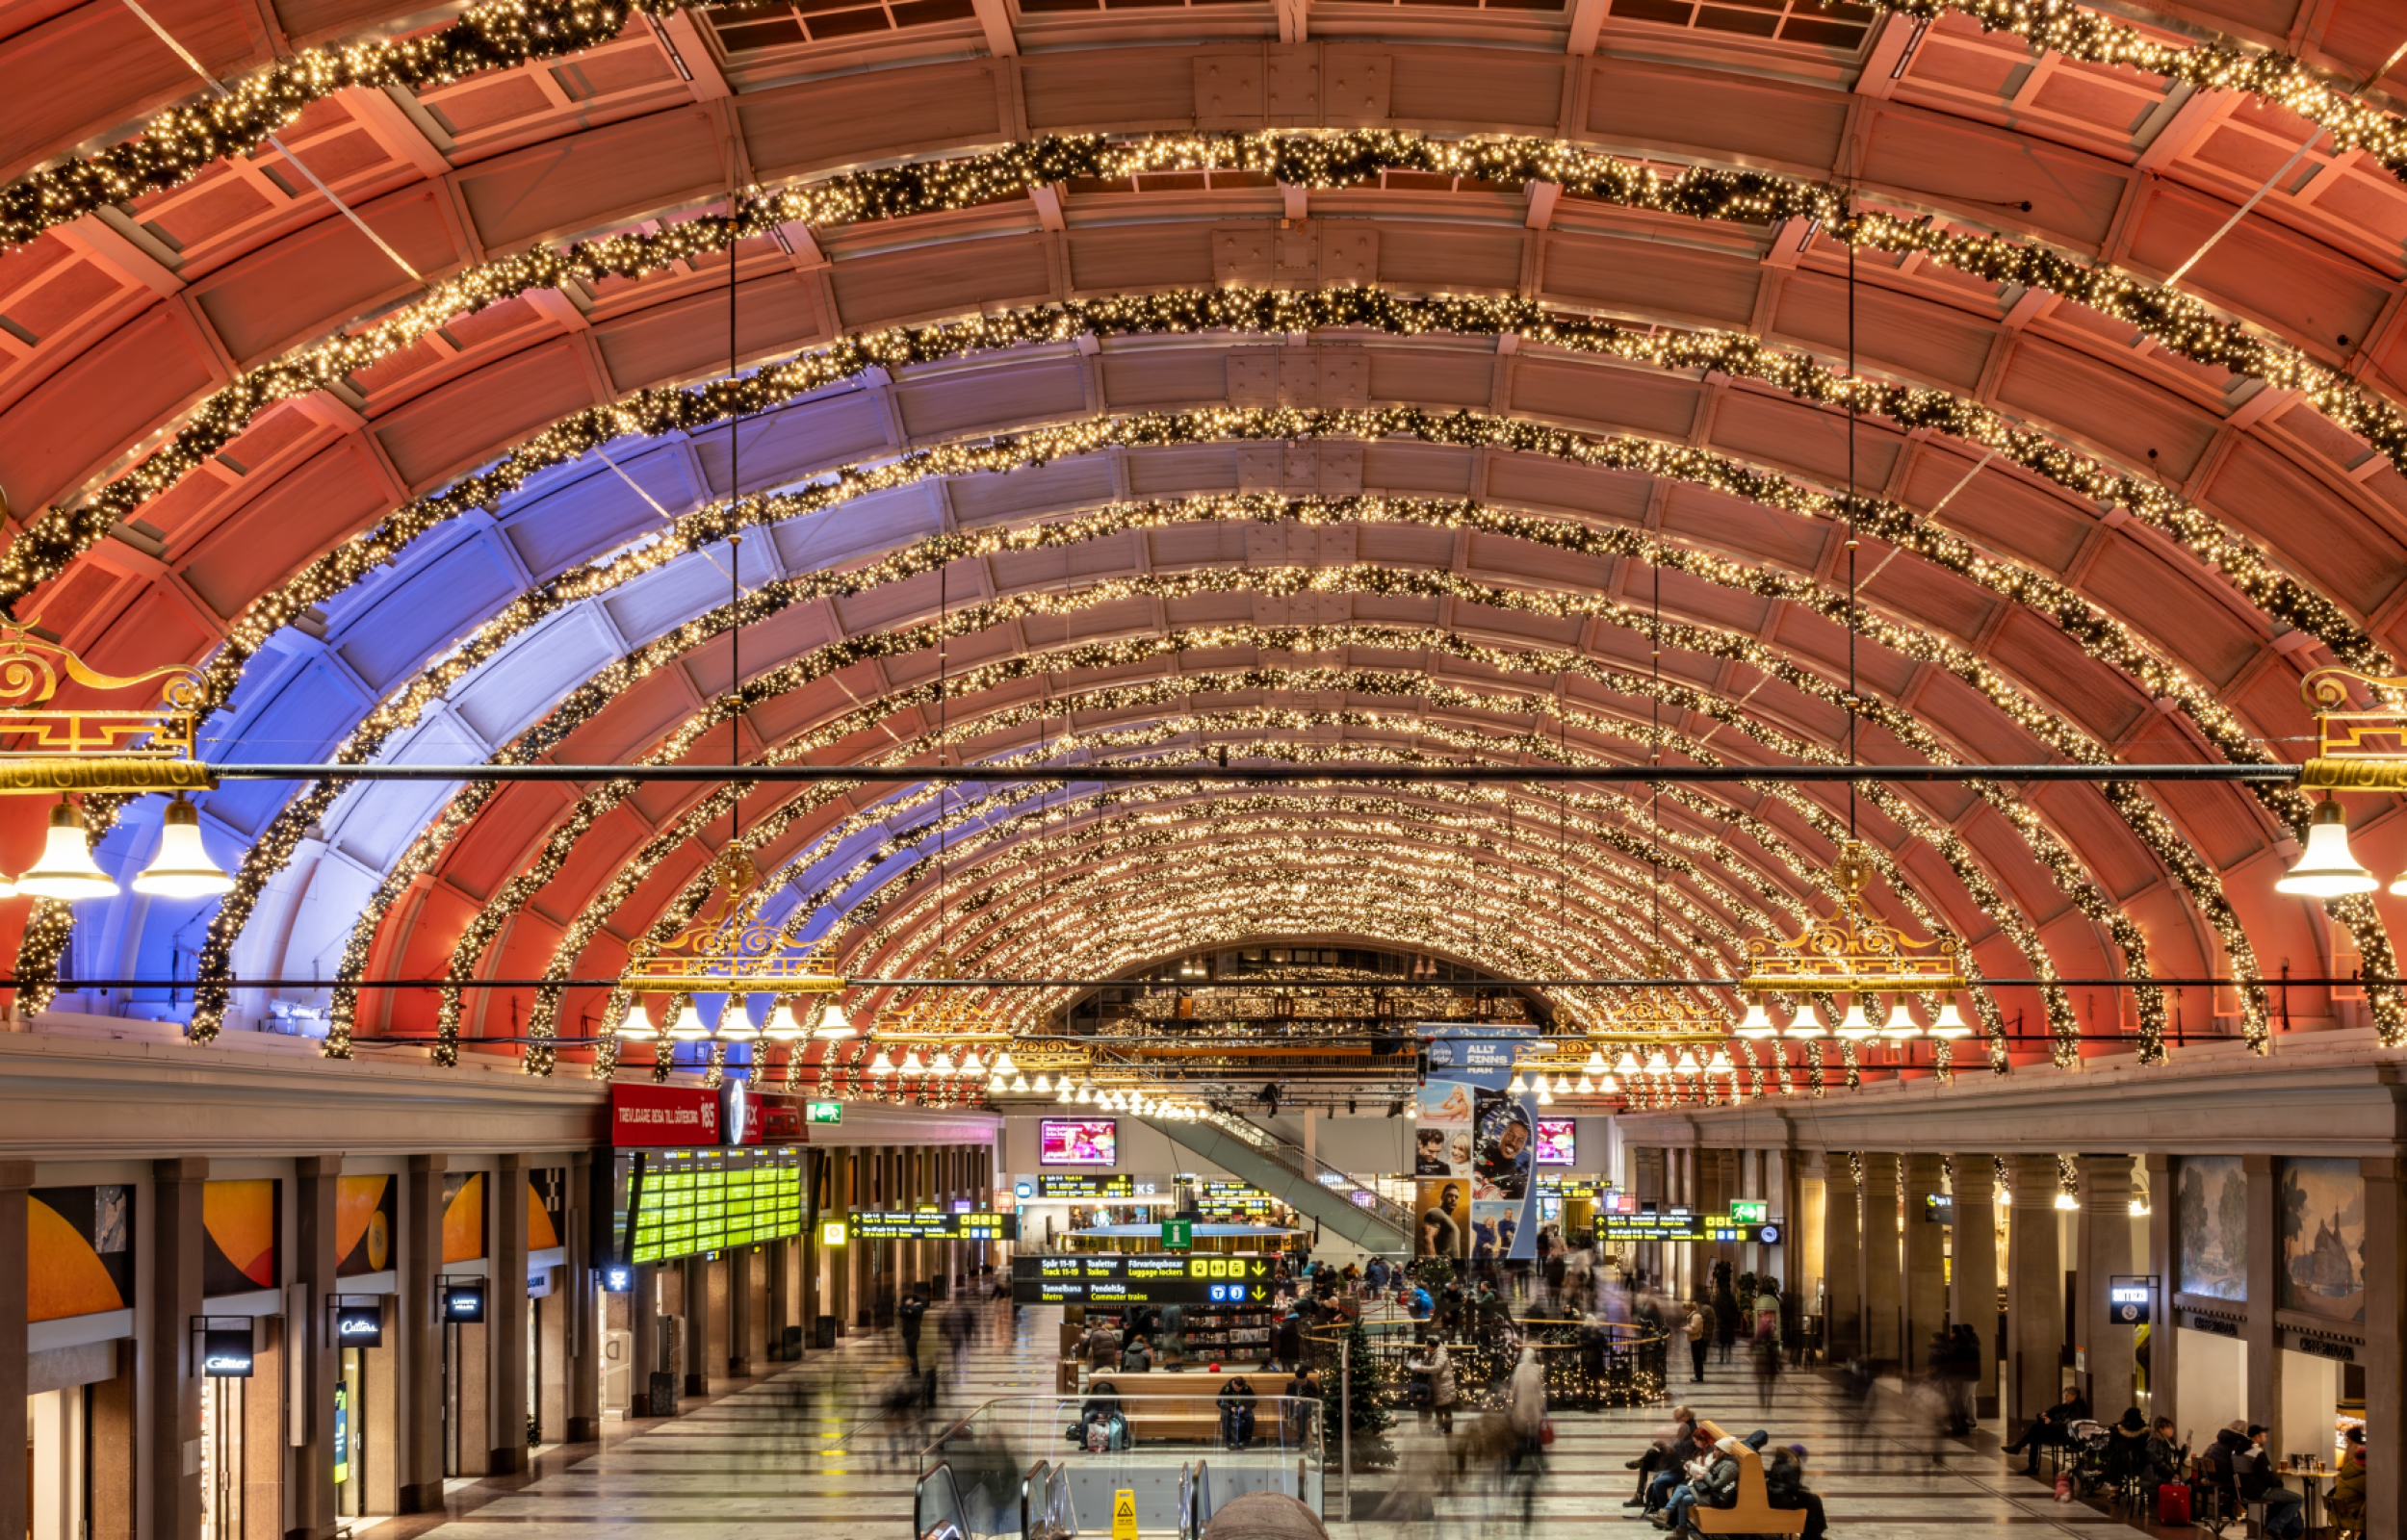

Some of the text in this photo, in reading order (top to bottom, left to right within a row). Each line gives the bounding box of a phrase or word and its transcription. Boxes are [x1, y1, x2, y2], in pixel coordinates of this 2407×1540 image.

[1467, 1044, 1497, 1054] ALLT
[1467, 1055, 1508, 1064] FINNS
[1042, 1259, 1077, 1269] Spår 11-19
[1086, 1260, 1118, 1269] Toaletter
[1127, 1259, 1184, 1270] Förvaringsboxar
[1042, 1268, 1061, 1276] Track
[1087, 1268, 1109, 1276] Toilets
[1128, 1268, 1183, 1277] Luggage lockers
[1042, 1284, 1082, 1293] Tunnelbana
[1091, 1284, 1126, 1295] Pendeltåg
[1042, 1293, 1064, 1301] Metro
[1091, 1293, 1148, 1301] Commuter trains
[206, 1357, 250, 1369] Glitter
